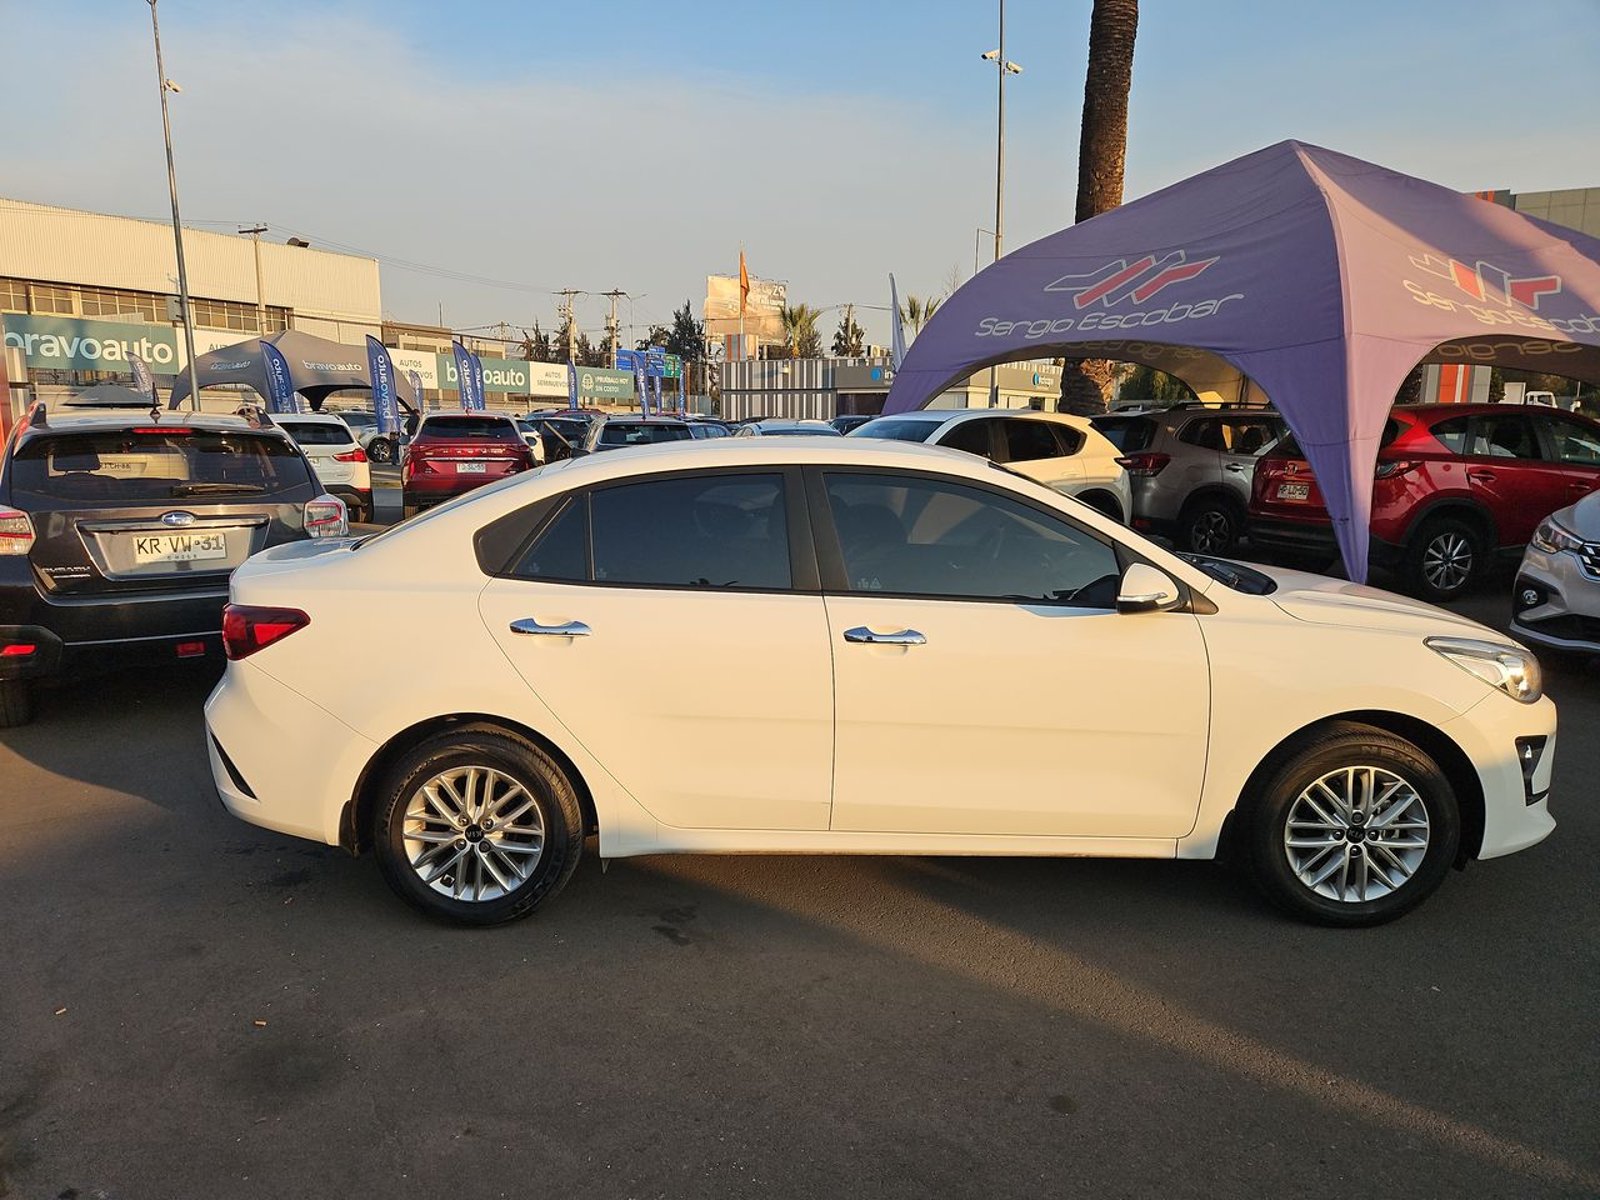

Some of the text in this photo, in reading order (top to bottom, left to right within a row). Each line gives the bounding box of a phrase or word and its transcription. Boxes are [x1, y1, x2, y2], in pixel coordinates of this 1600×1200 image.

[975, 293, 1245, 340] Sergio Escobar
[302, 359, 363, 372] bravoauto
[399, 359, 422, 368] AUTOS
[446, 361, 526, 387] boauto
